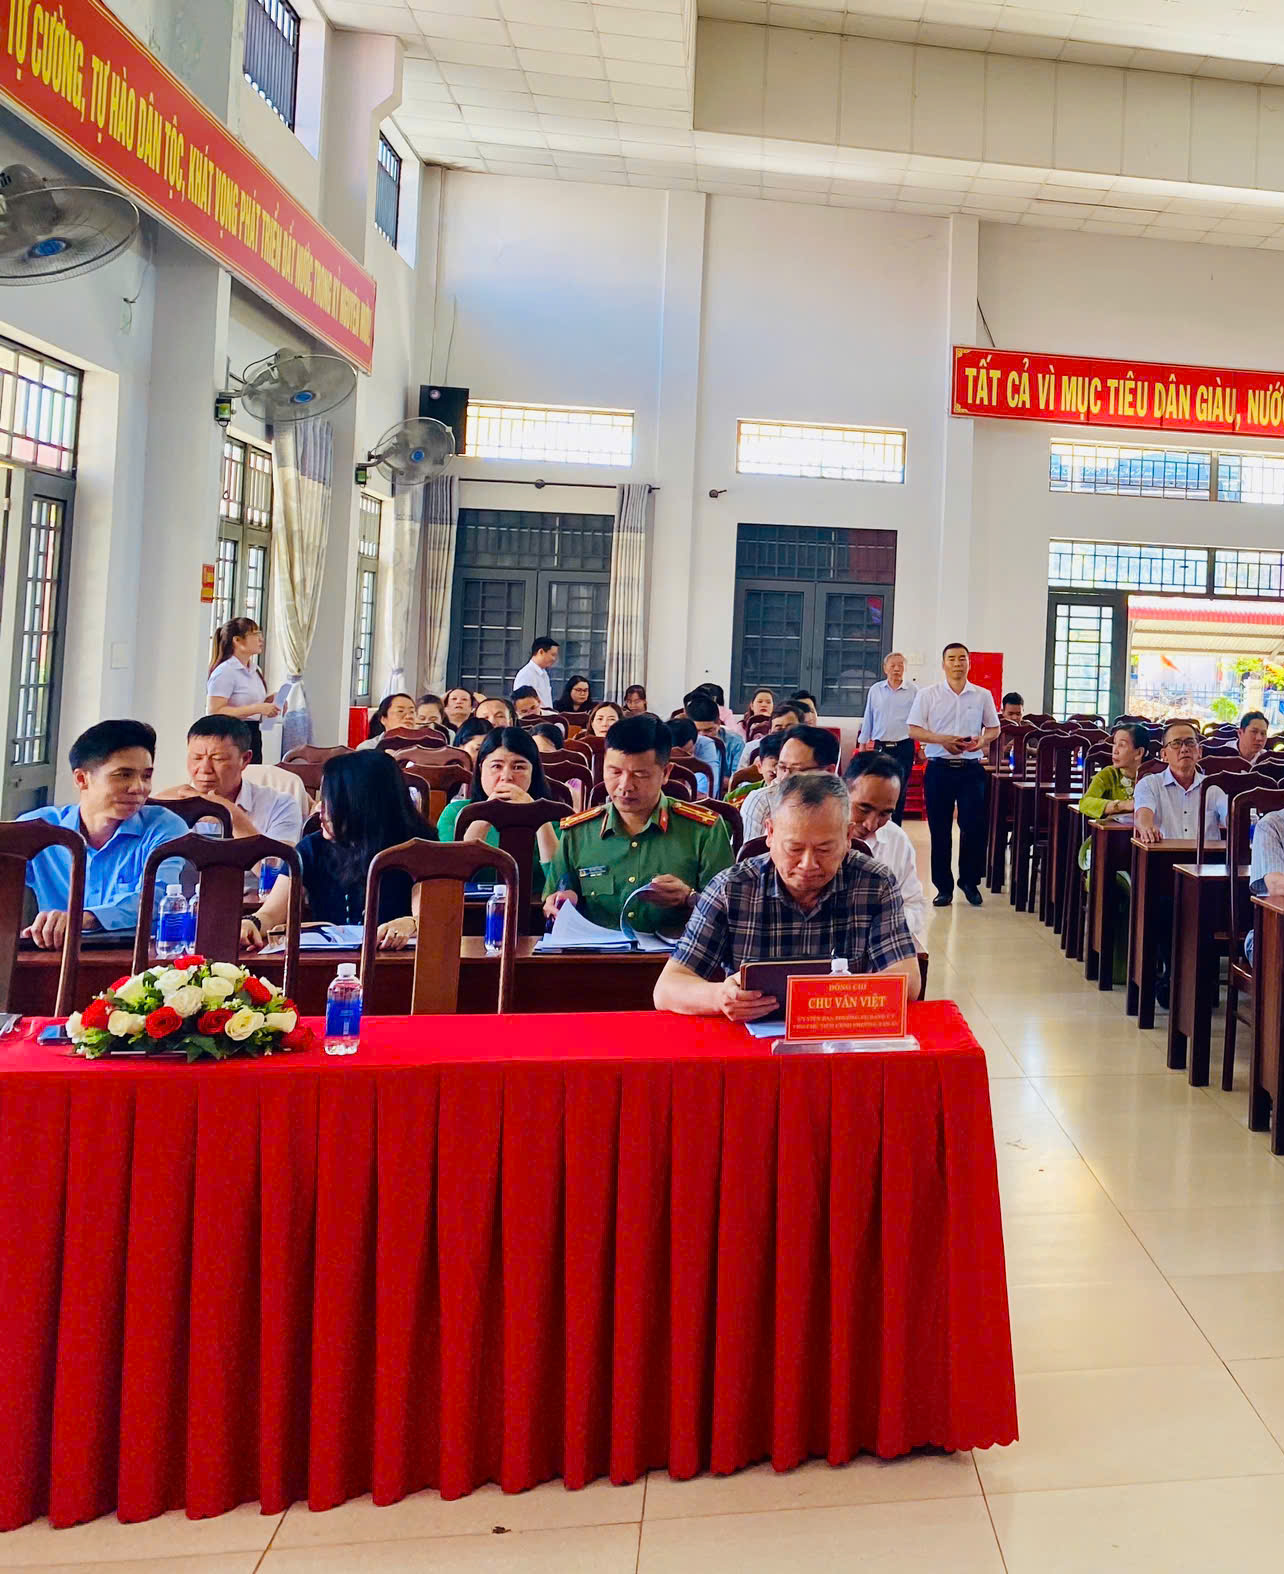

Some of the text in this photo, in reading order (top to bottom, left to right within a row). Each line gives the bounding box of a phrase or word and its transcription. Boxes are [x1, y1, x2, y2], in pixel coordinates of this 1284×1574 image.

[31, 3, 86, 122] CƯỜNG,
[90, 54, 111, 144] TỰ
[108, 66, 136, 151] HÀO
[136, 91, 163, 174] DÂN
[164, 115, 185, 201] TỘC,
[188, 143, 214, 216] KHÁT
[214, 166, 240, 239] VỌNG
[239, 189, 261, 253] PHÁT
[964, 354, 1001, 406] TẤT
[1006, 357, 1031, 409] CẢ
[1037, 364, 1056, 411] VÌ
[1060, 374, 1102, 421] MỤC
[1106, 370, 1149, 417] TIÊU
[1153, 373, 1191, 421] DÂN
[1195, 376, 1242, 431] GIÀU,
[808, 992, 887, 1010] CHU VĂN VIỆT
